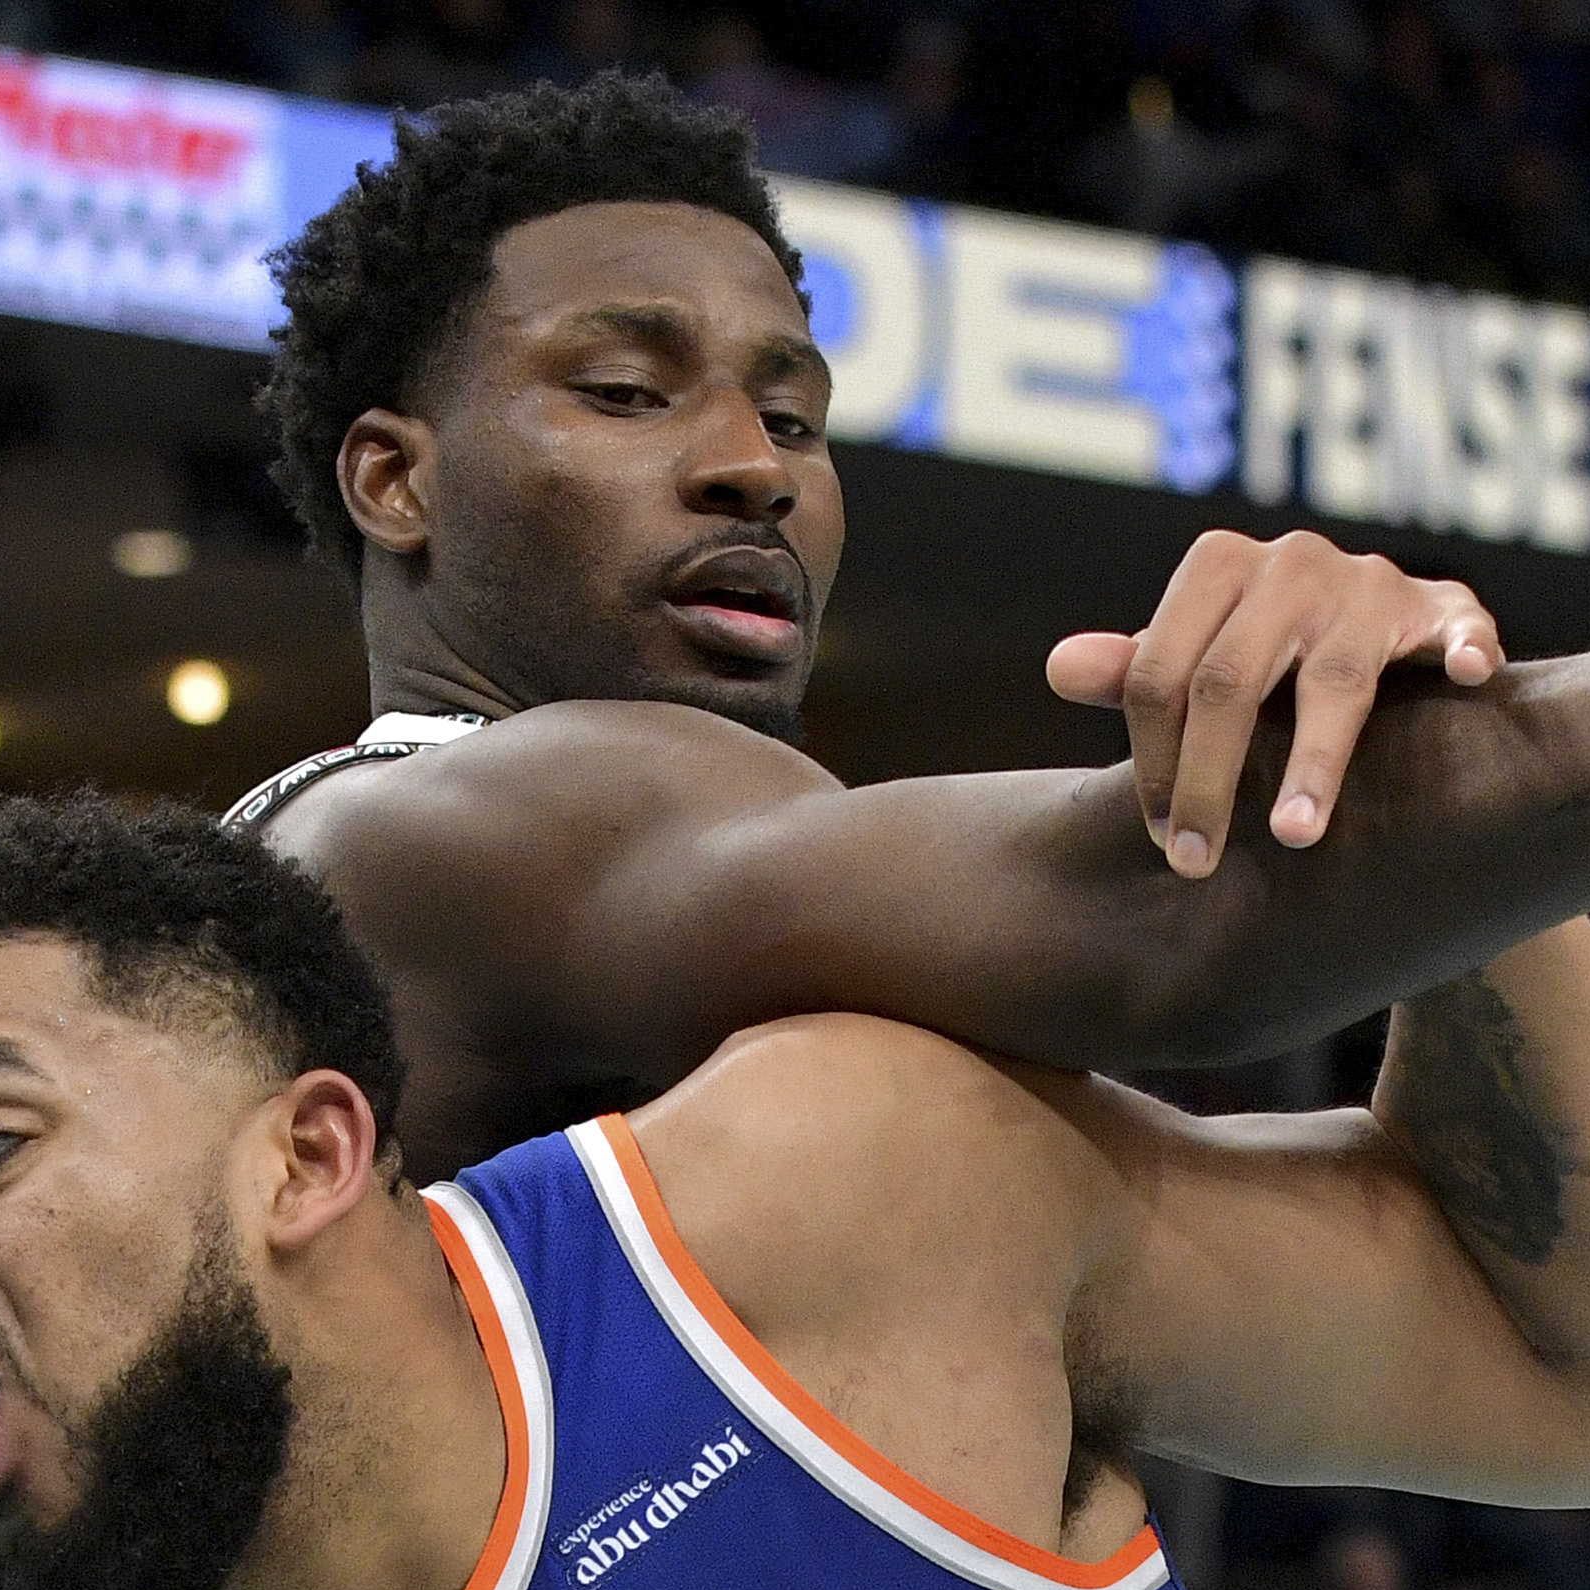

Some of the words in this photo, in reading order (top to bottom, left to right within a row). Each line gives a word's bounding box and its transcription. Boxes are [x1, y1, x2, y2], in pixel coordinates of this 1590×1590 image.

[559, 1478, 652, 1554] experience
[576, 1519, 650, 1585] abu
[645, 1426, 751, 1529] dhabi
